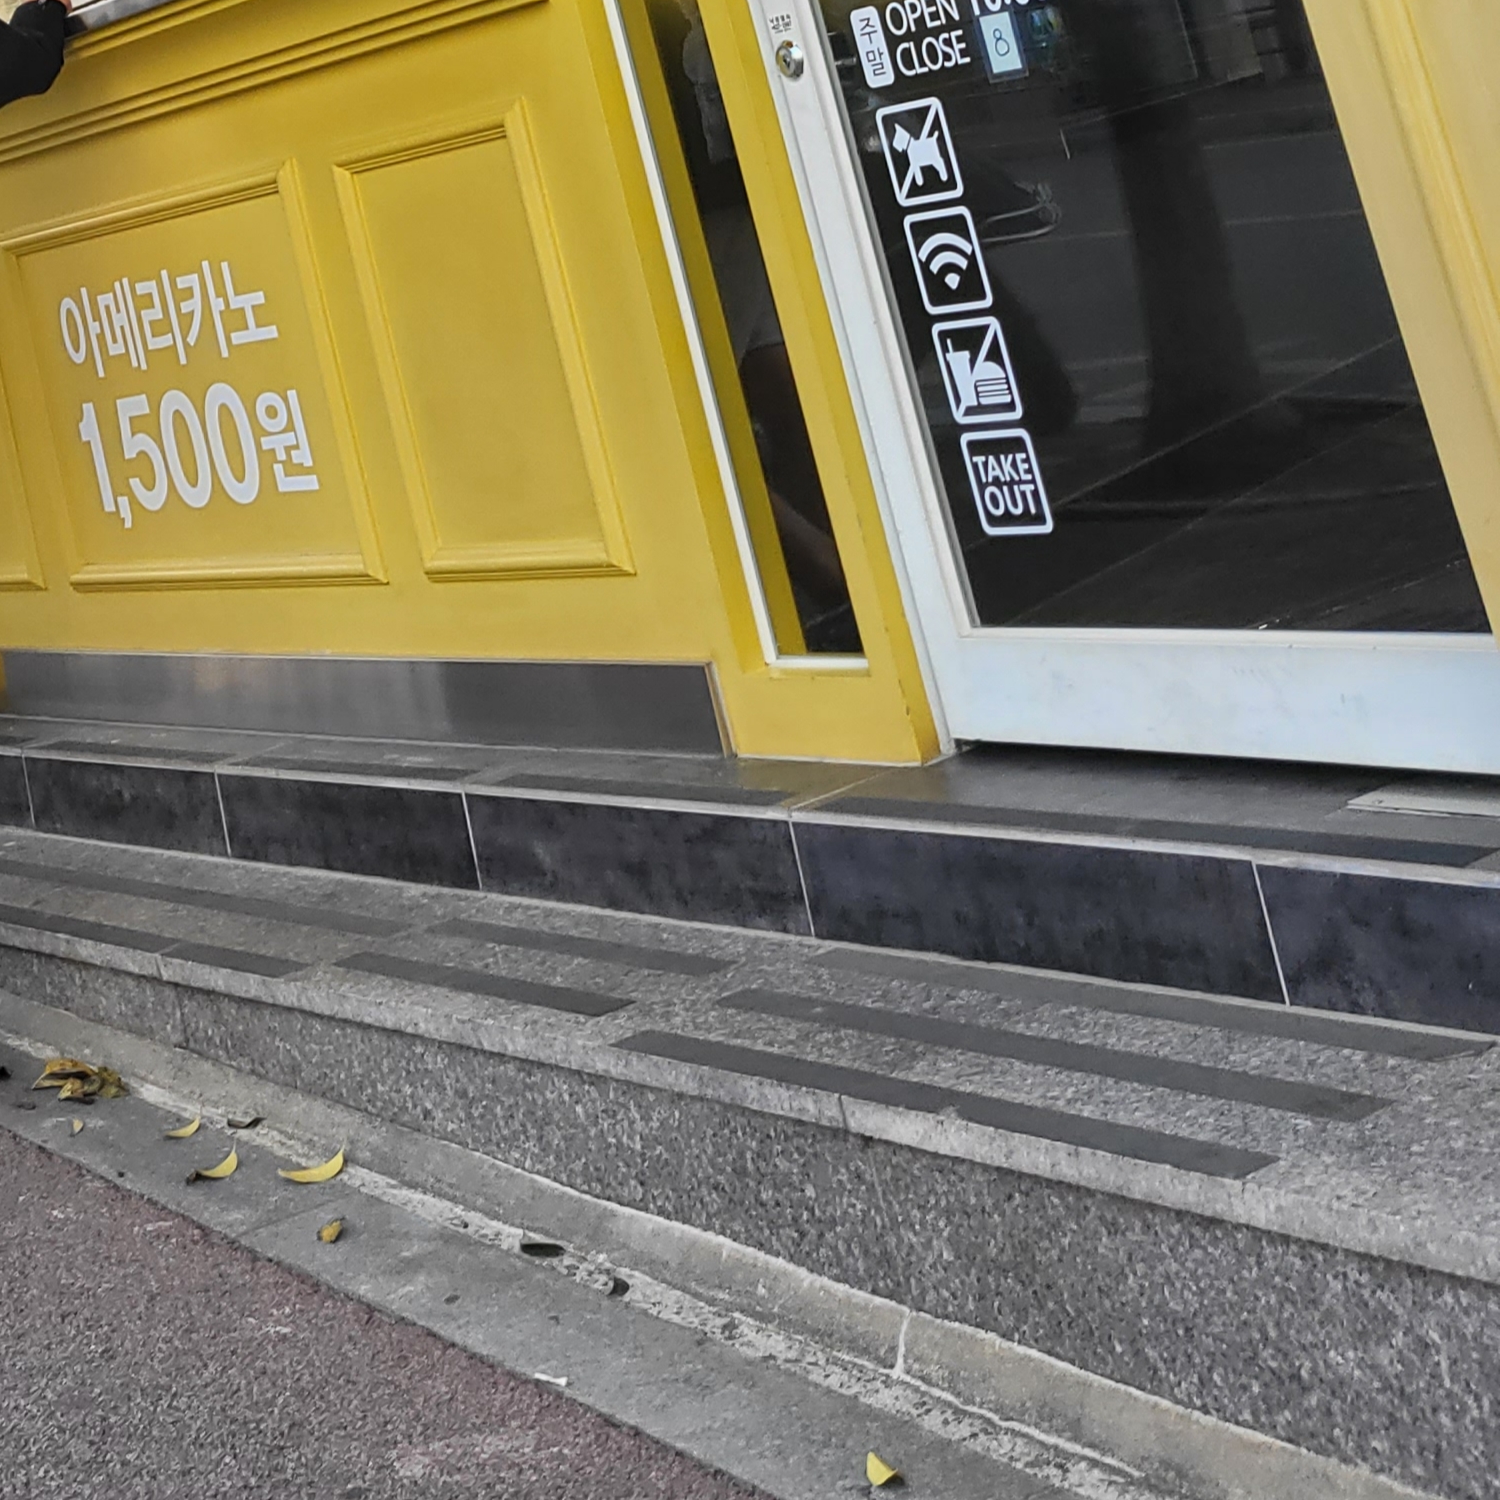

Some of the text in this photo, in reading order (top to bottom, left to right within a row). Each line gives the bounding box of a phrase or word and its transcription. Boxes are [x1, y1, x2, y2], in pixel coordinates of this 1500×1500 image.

[858, 16, 888, 77] 주말
[896, 27, 1011, 77] CLOSE 8
[59, 259, 280, 379] 아메리카노
[78, 381, 321, 530] 1,500원
[972, 452, 1033, 484] TAKE
[984, 483, 1037, 517] OUT
